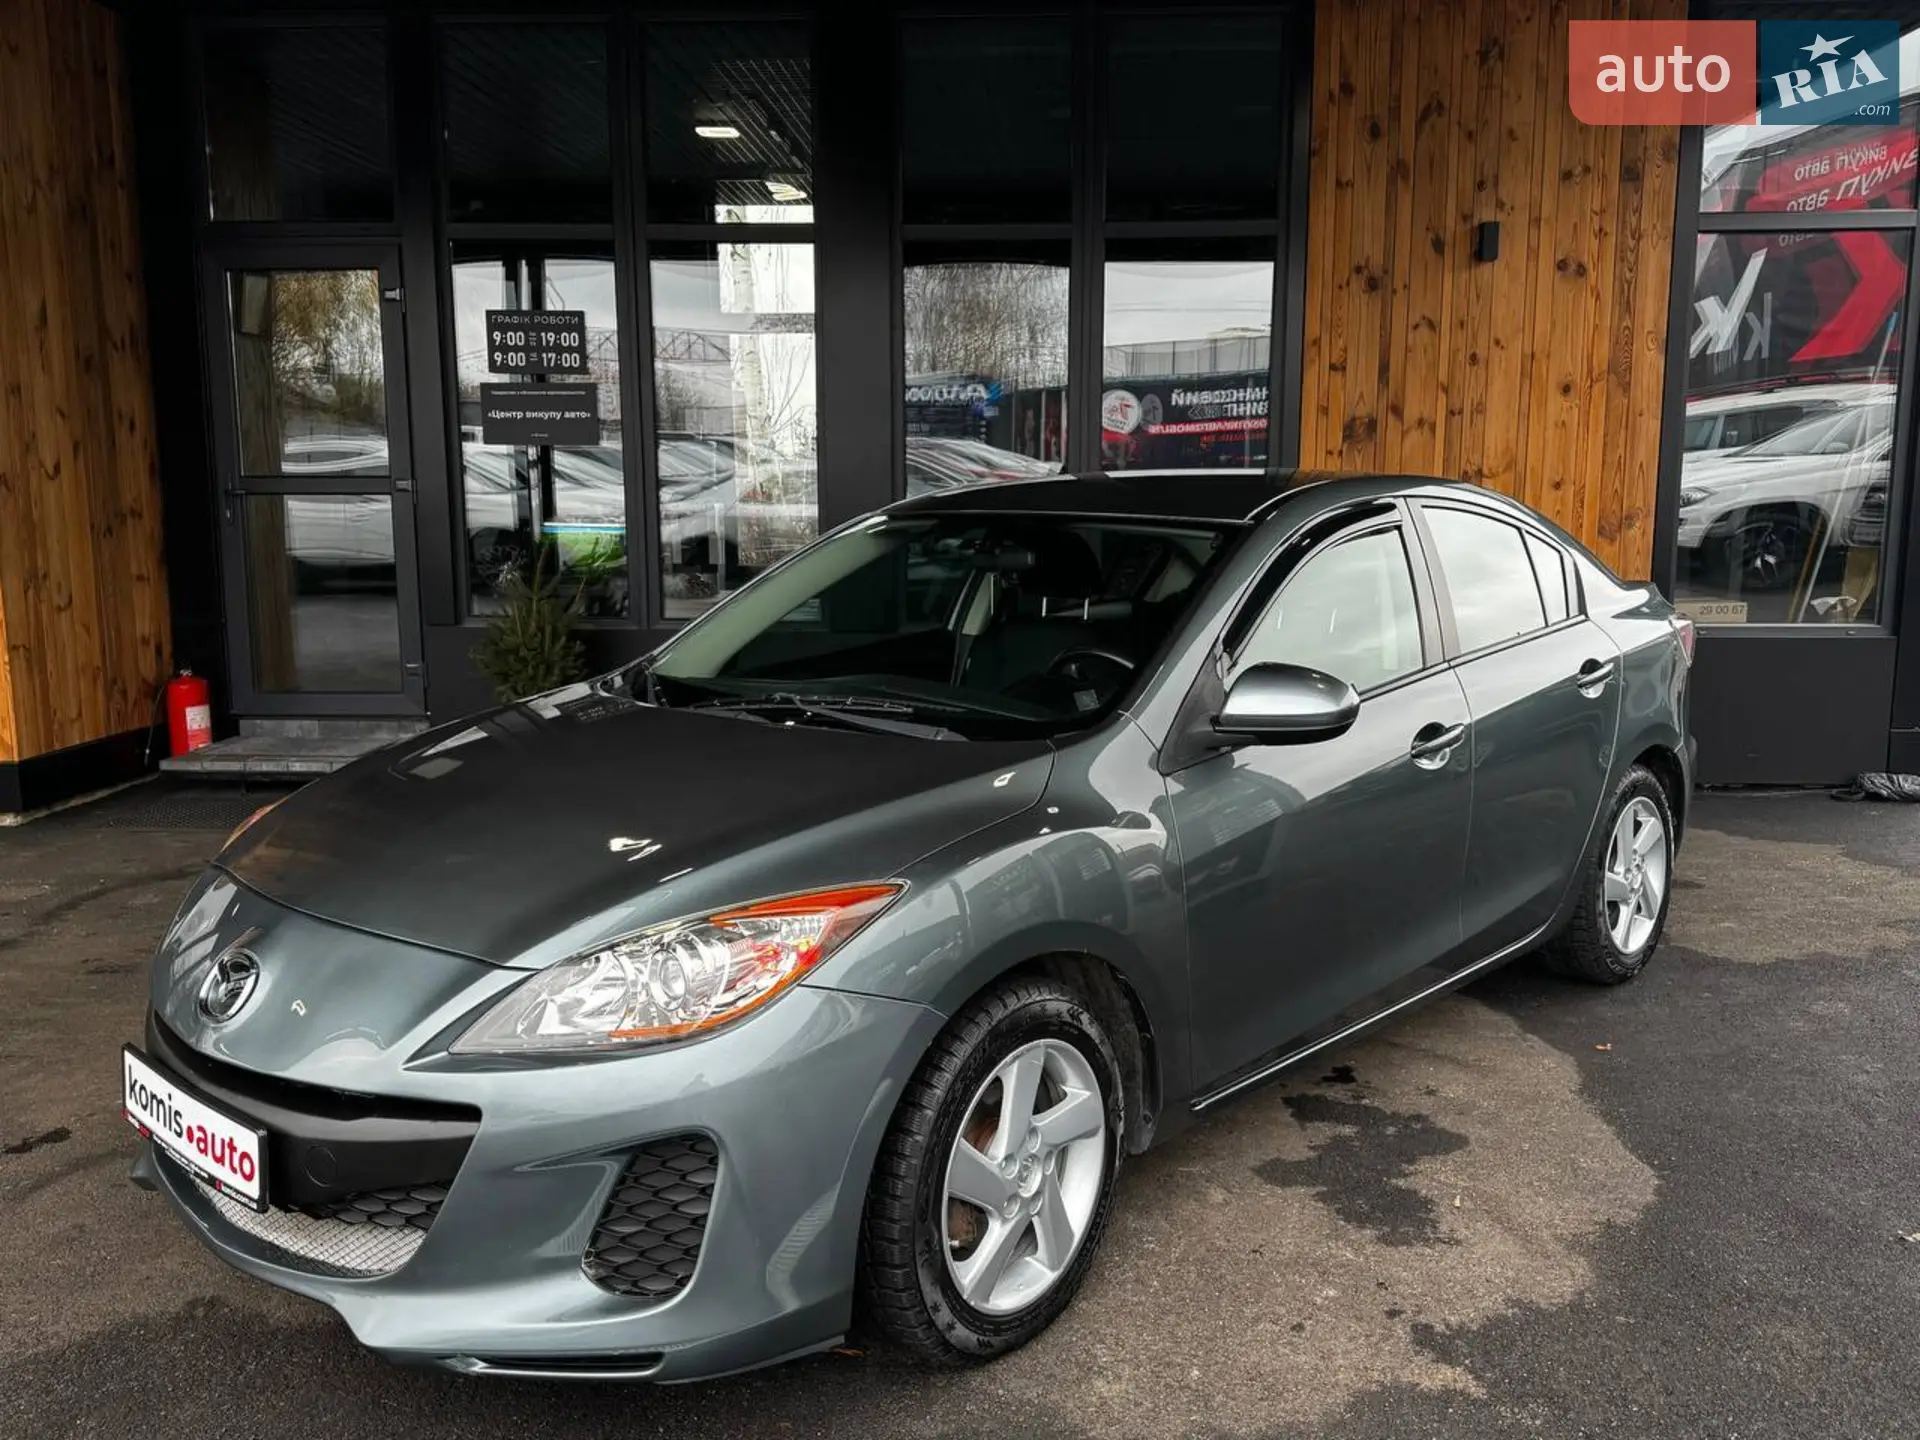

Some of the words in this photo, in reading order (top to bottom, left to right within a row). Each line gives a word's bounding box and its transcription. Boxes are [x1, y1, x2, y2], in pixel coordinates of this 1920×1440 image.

[491, 315, 531, 325] ГРАФІК
[533, 315, 579, 325] РОБОТИ
[492, 330, 525, 346] 9:00
[540, 331, 579, 347] 19:00
[494, 351, 526, 367] 9:00
[541, 352, 580, 368] 17:00
[526, 411, 562, 421] викупу
